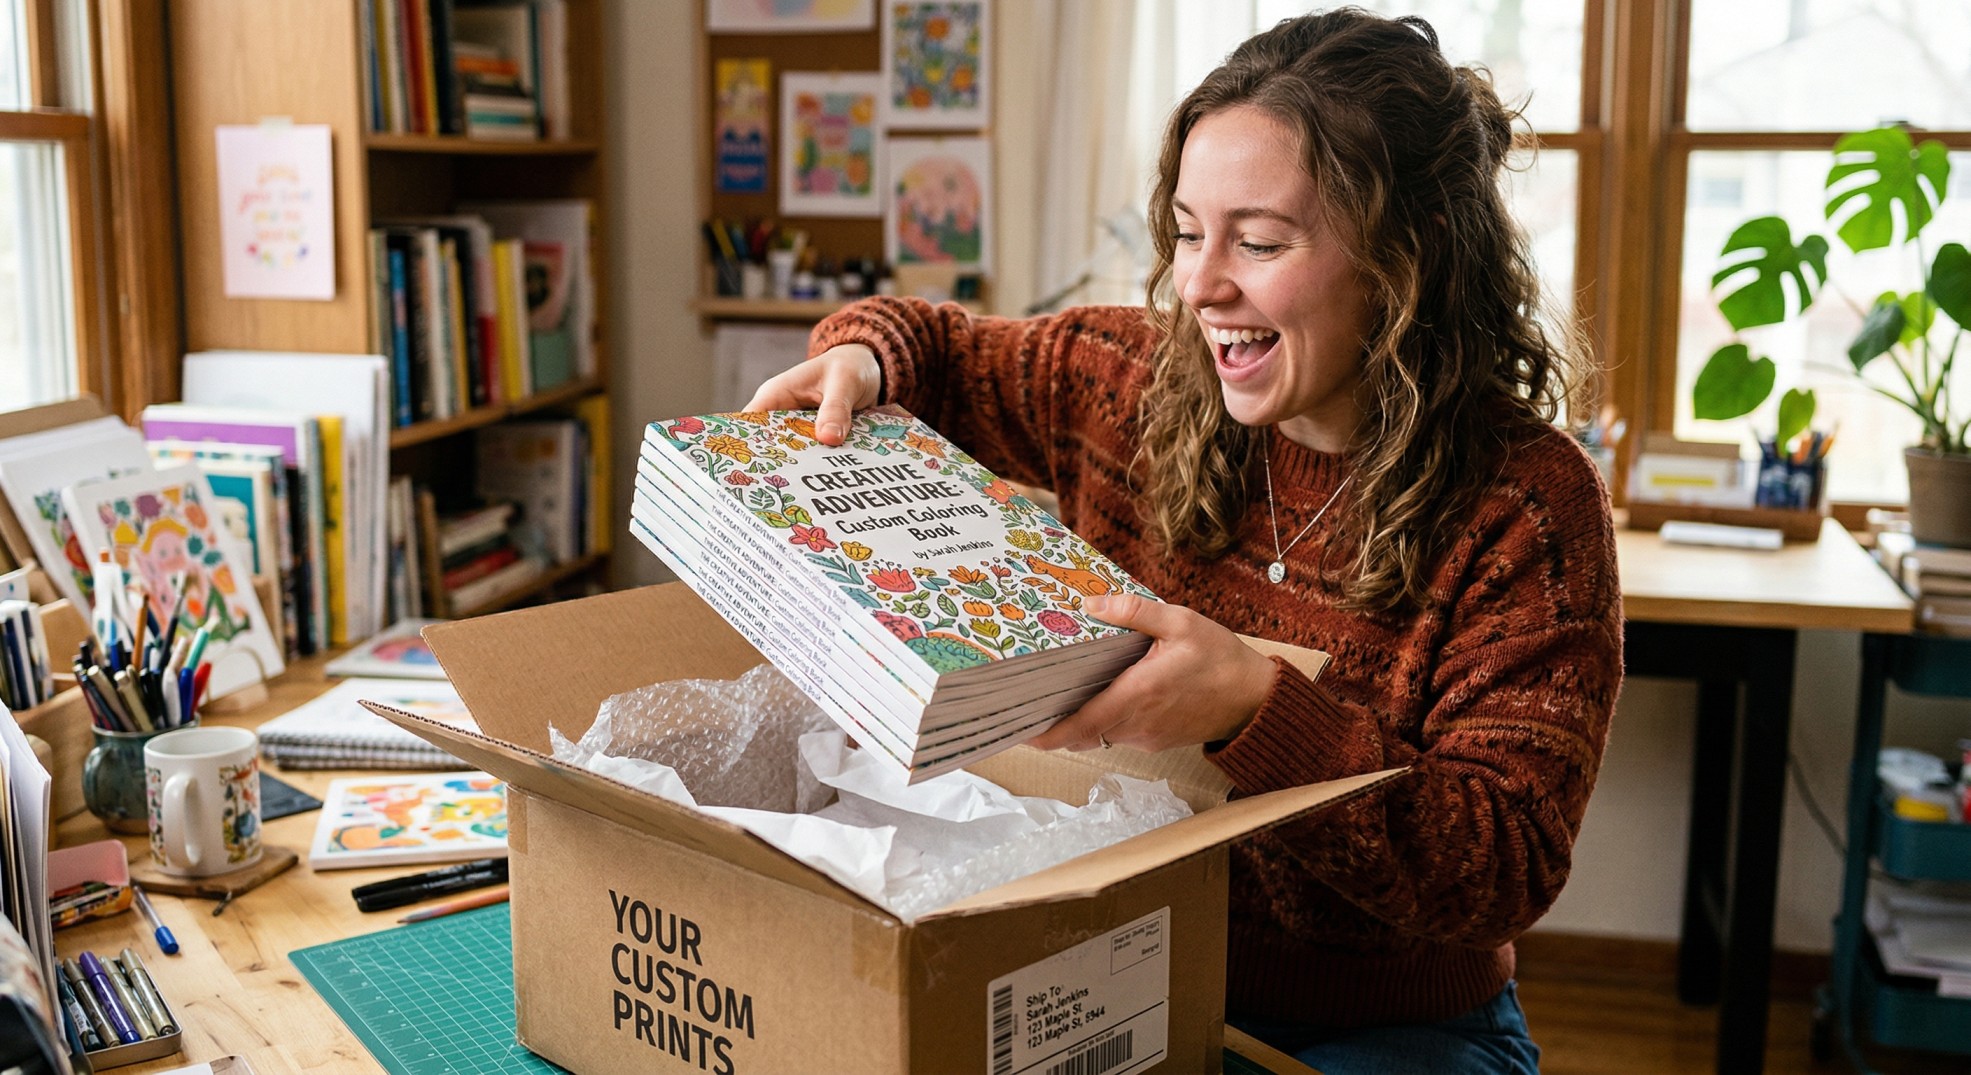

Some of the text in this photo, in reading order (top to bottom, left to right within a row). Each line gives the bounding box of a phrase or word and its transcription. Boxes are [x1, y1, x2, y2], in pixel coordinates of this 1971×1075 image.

[800, 463, 925, 493] CREATIVE
[822, 454, 864, 468] THE
[716, 488, 726, 501] THE
[727, 498, 753, 524] CREATIVE
[811, 480, 965, 516] ADVENTURE:
[711, 504, 722, 518] THE
[722, 514, 747, 540] CREATIVE
[835, 501, 989, 535] Custom Coloring
[908, 523, 961, 542] Book
[704, 536, 713, 548] THE
[713, 545, 737, 570] CREATIVE
[706, 520, 716, 532] THE
[717, 529, 741, 554] CREATIVE
[912, 540, 994, 560] by Sarah Jenkins
[698, 566, 708, 579] THE
[708, 575, 733, 601] CREATIVE
[700, 551, 710, 564] THE
[710, 560, 735, 586] CREATIVE
[696, 582, 706, 595] THE
[706, 592, 731, 617] CREATIVE
[608, 889, 703, 967] YOUR
[611, 942, 755, 1040] CUSTOM
[1026, 992, 1048, 1007] Ship
[1026, 987, 1089, 1021] Sarah Jenkins
[613, 989, 735, 1075] PRINTS
[1027, 1020, 1042, 1035] 123
[1045, 1009, 1070, 1028] Maple
[1027, 1033, 1042, 1049] 123
[1045, 1022, 1070, 1041] Maple
